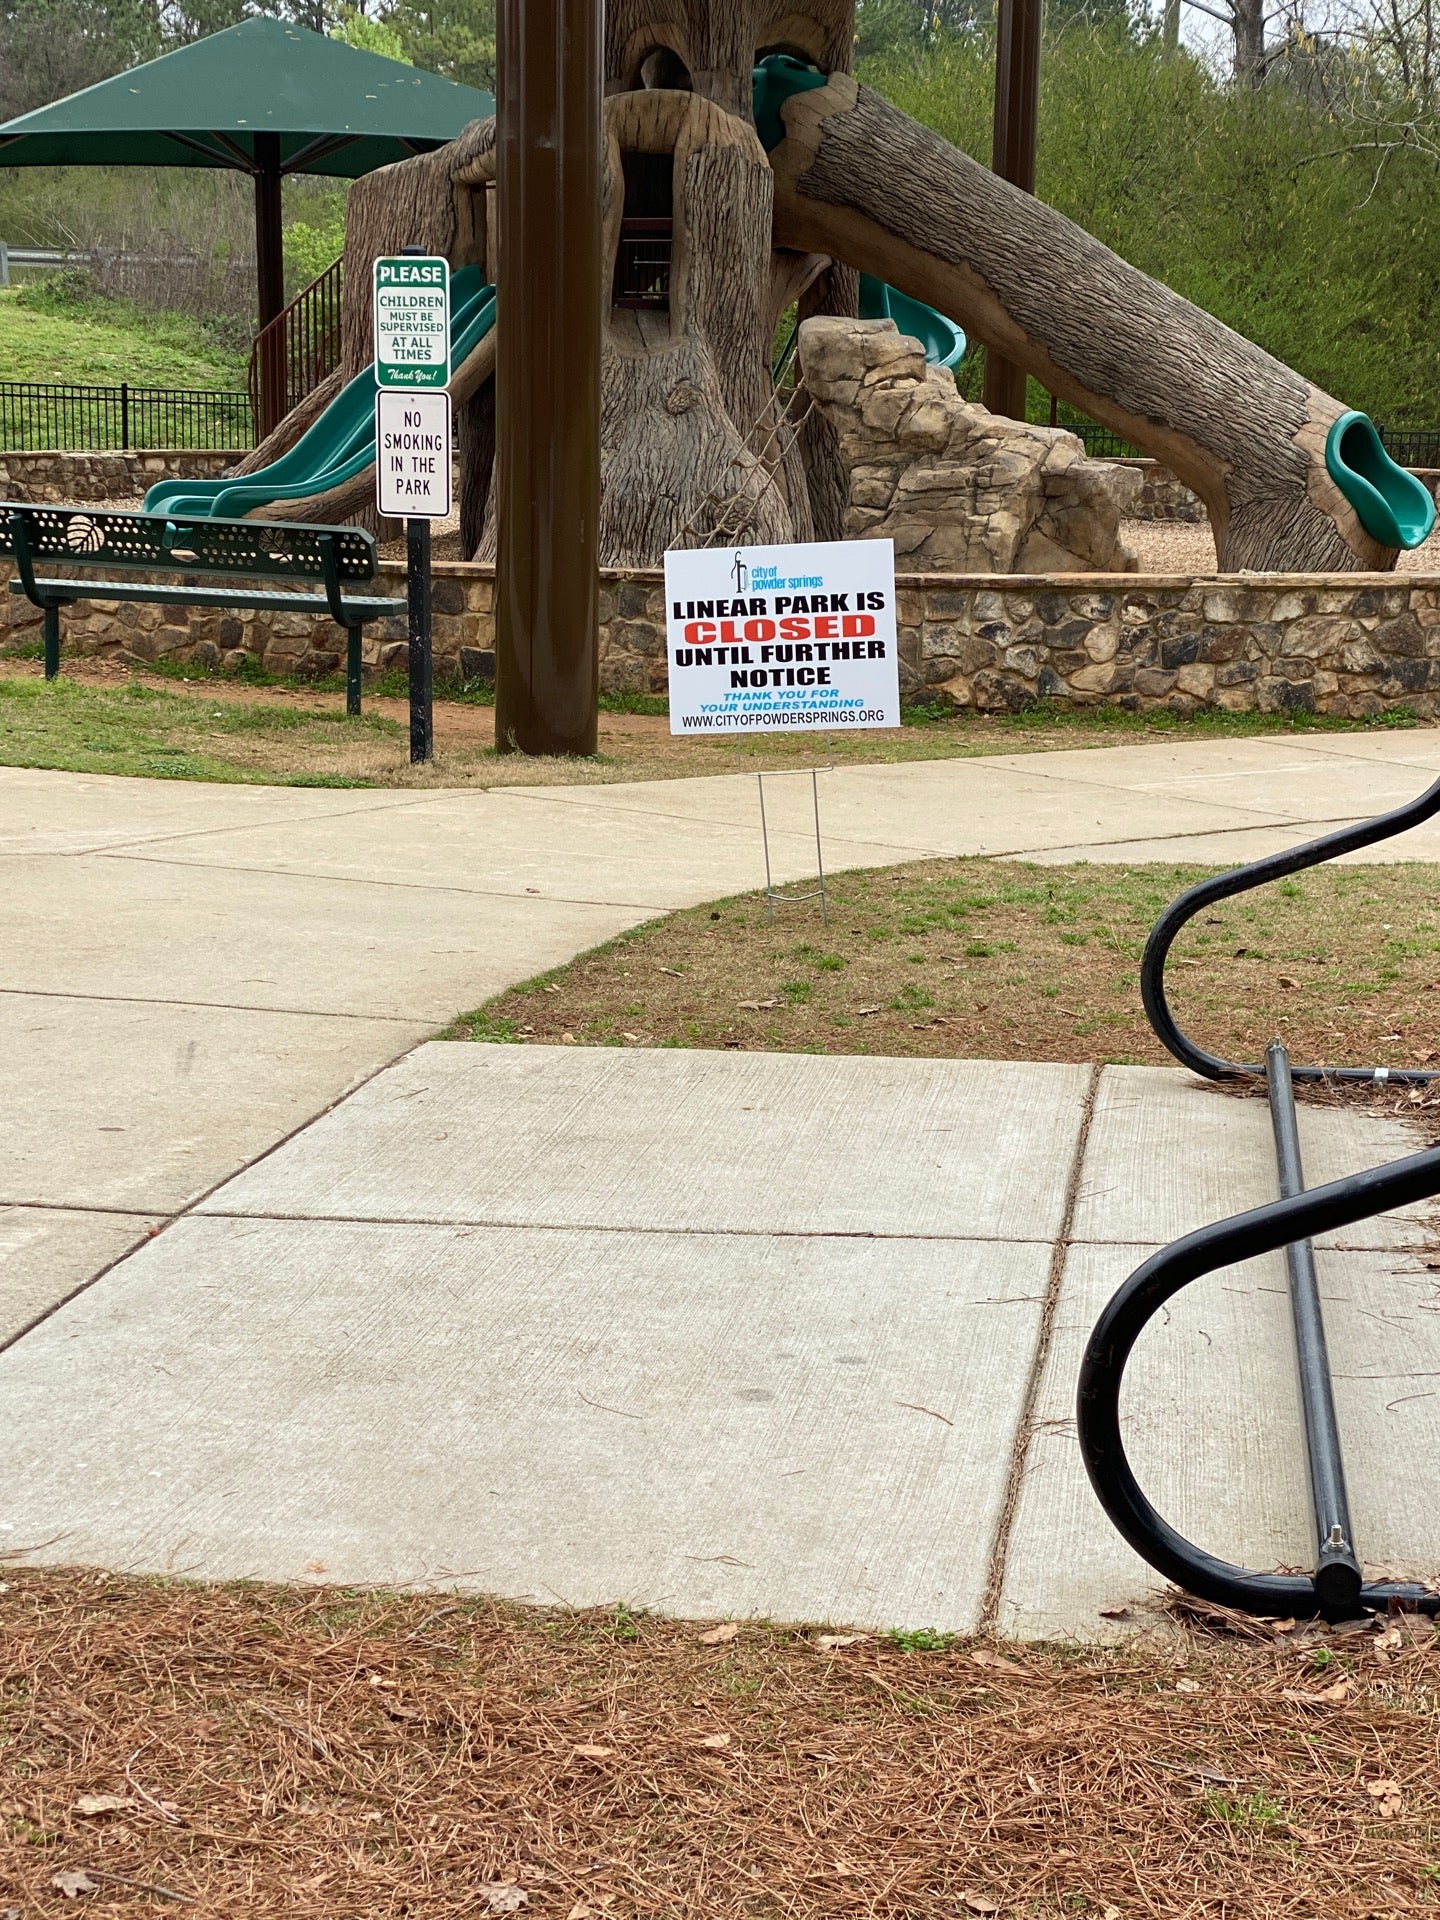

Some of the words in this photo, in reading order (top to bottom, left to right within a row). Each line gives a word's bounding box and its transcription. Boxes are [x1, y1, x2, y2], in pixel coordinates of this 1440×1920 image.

[380, 266, 442, 282] PLEASE
[380, 296, 443, 307] CHILDREN
[390, 312, 417, 321] MUST
[421, 312, 433, 321] BE
[380, 322, 443, 332] SUPERVISED
[392, 337, 407, 347] AT
[411, 337, 432, 348] ALL
[393, 349, 432, 360] TIMES
[387, 369, 414, 380] Thank
[414, 370, 437, 383] You!
[404, 411, 421, 427] NO
[384, 433, 442, 451] SMOKING
[391, 456, 403, 472] IN
[412, 457, 435, 473] THE
[396, 479, 431, 495] PARK
[752, 578, 786, 591] powder
[788, 576, 823, 590] springs
[673, 598, 767, 619] LINEAR
[775, 594, 849, 614] PARK
[856, 592, 885, 611] IS
[684, 614, 875, 644] CLOSED
[676, 647, 754, 666] UNTIL
[761, 641, 885, 663] FURTHER
[730, 667, 831, 688] NOTICE
[723, 691, 772, 701] THANK
[778, 690, 806, 699] YOU
[810, 689, 839, 697] FOR
[700, 704, 737, 712] YOUR
[743, 699, 864, 711] UNDERSTANDING
[682, 710, 884, 727] WWW.CITYOFPOWDERSPRINGS.ORG
